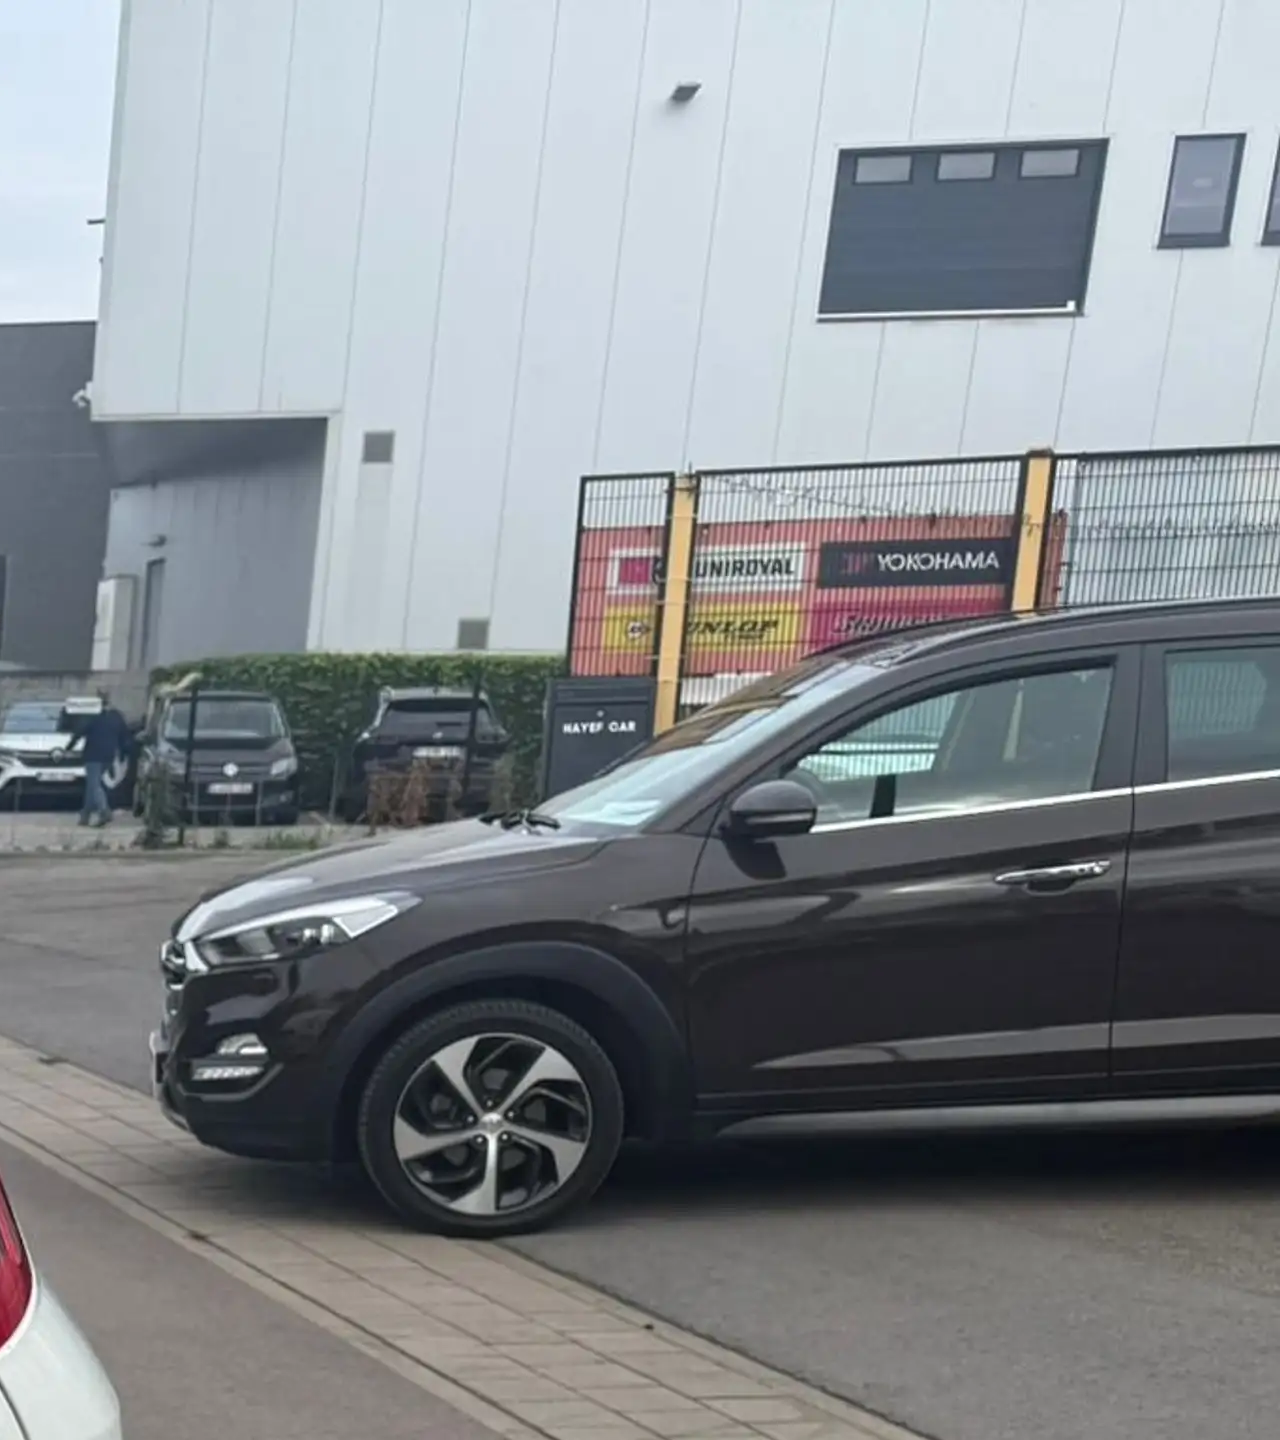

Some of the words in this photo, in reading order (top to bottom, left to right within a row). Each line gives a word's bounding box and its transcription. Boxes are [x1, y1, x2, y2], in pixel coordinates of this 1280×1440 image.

[695, 558, 795, 578] UNIROYAL
[877, 551, 1000, 571] YOKOHAMA
[686, 619, 779, 635] UNLOP
[608, 721, 636, 732] CAR
